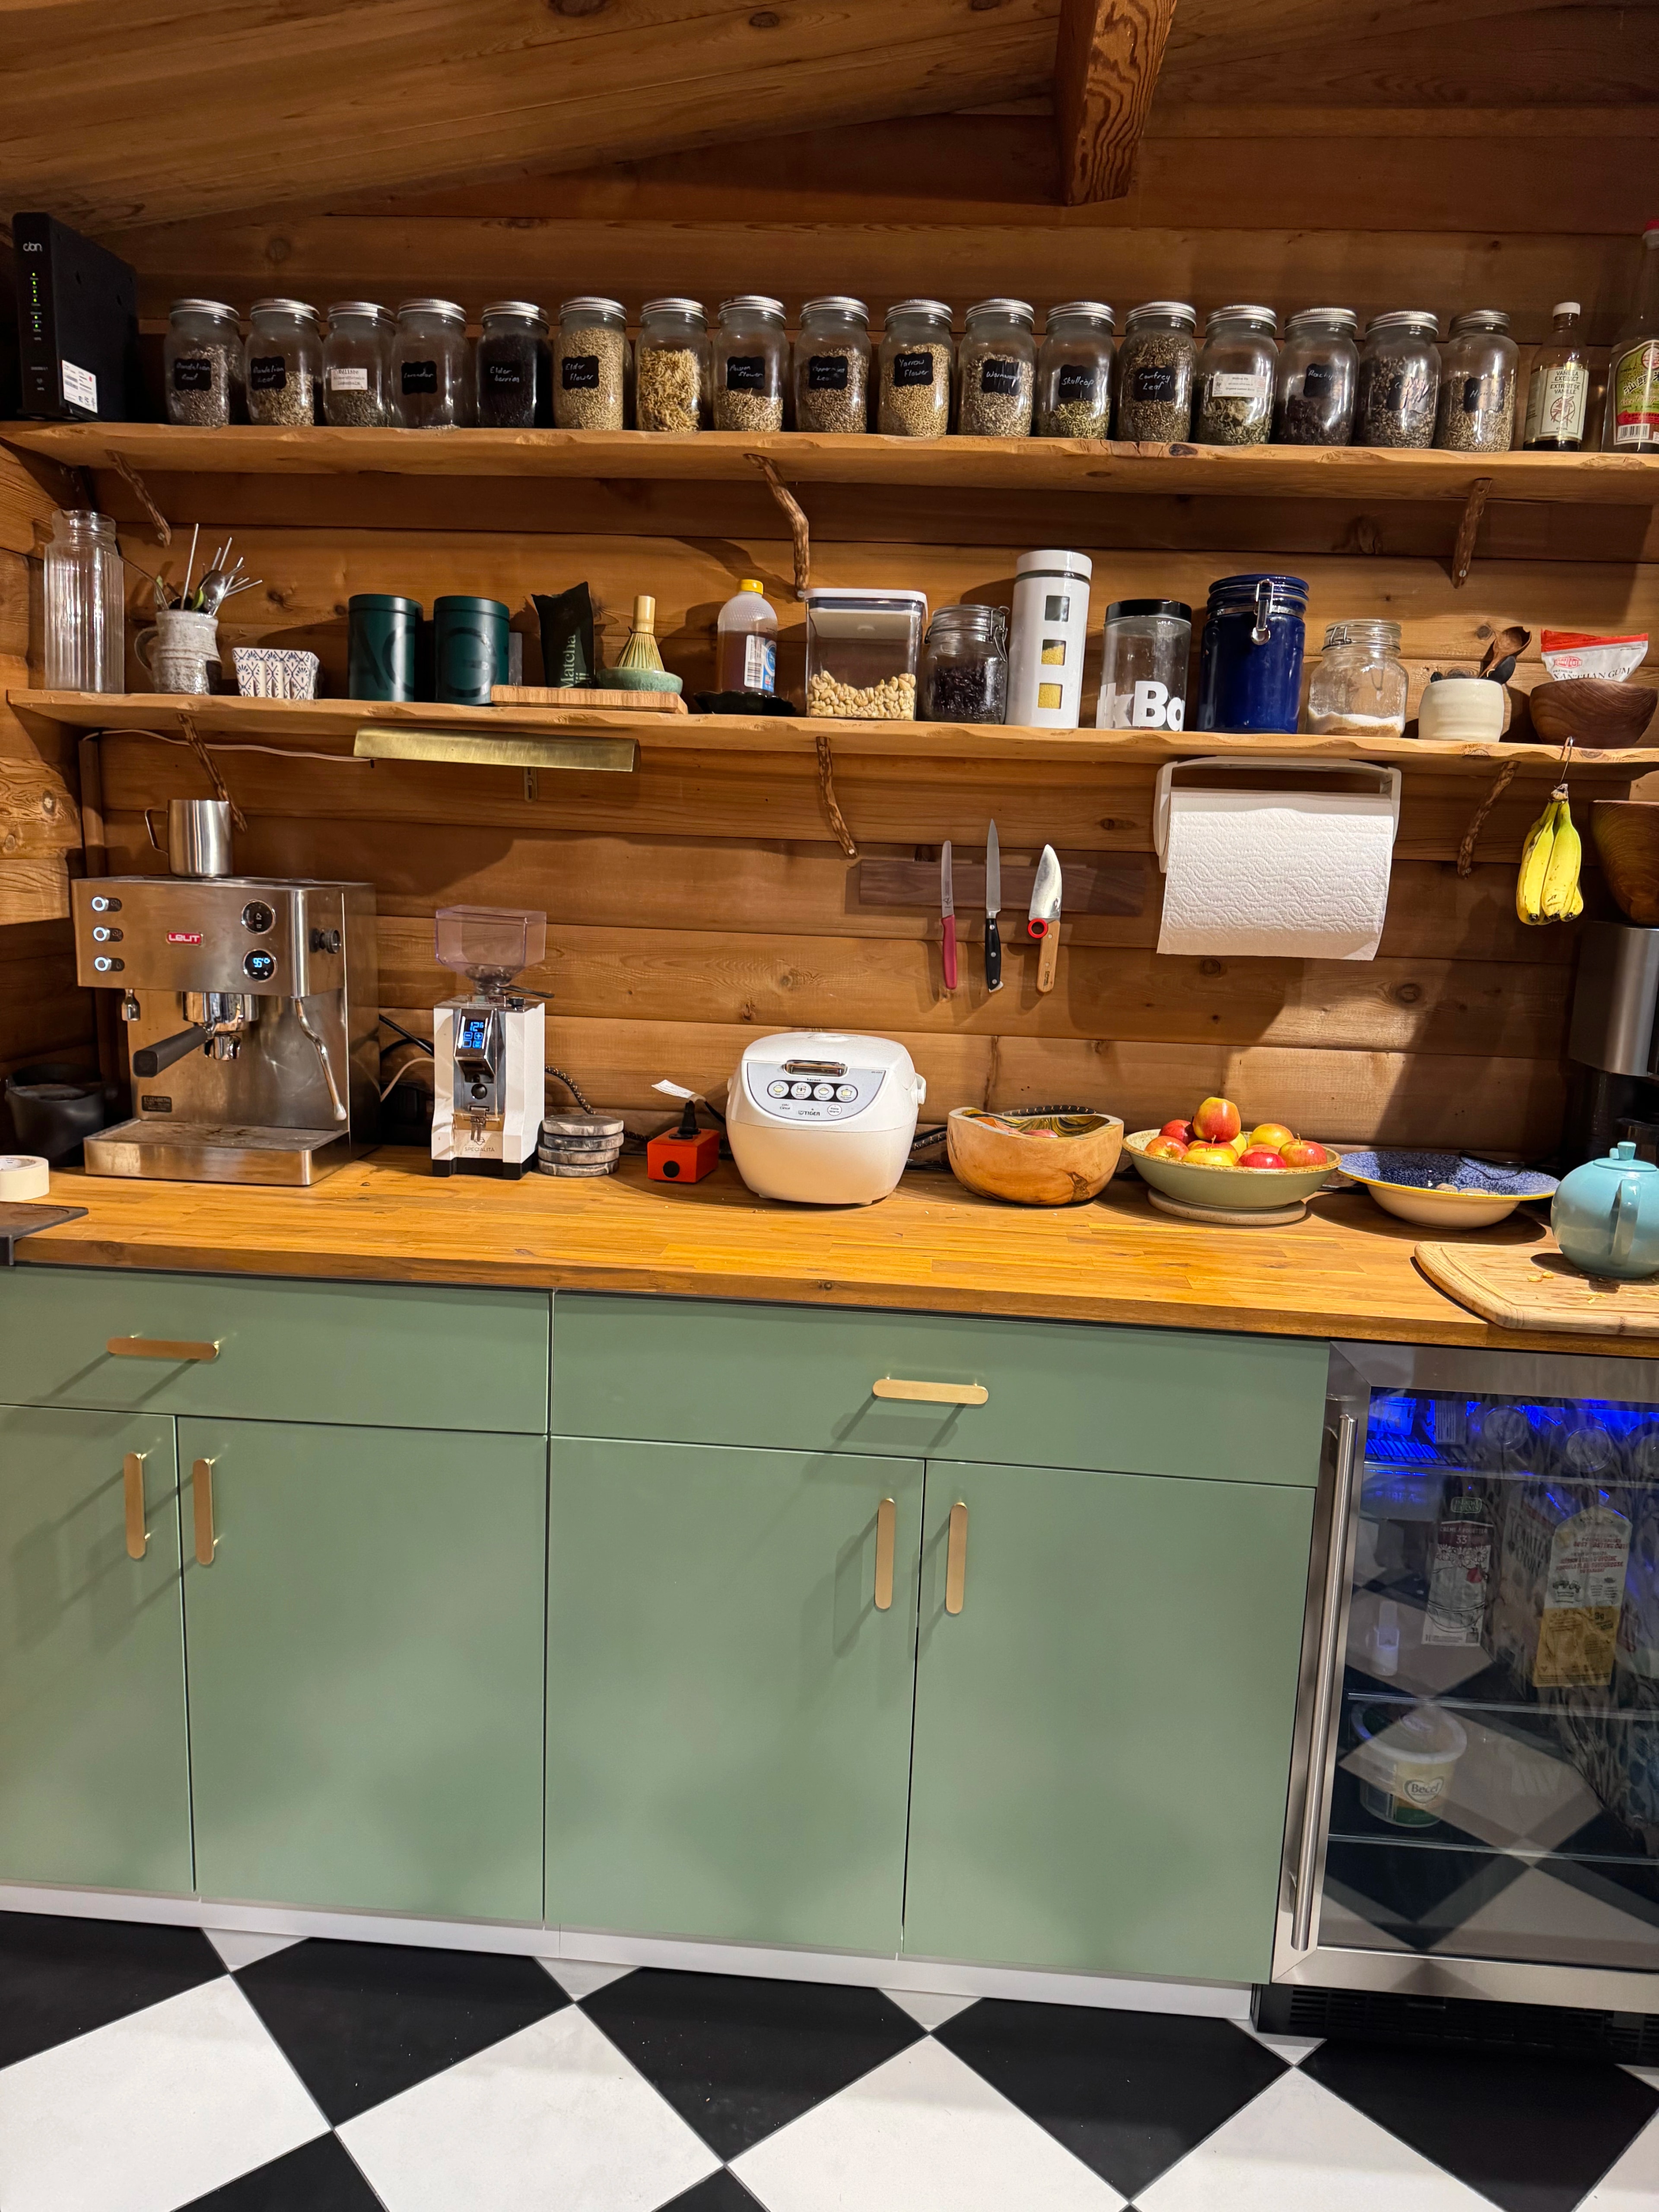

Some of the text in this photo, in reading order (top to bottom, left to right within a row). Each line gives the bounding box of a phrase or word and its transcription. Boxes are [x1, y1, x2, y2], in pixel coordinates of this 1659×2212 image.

[899, 359, 925, 367] Yarrow
[1062, 376, 1094, 388] Skullcap
[1138, 371, 1171, 384] Comfrey
[1142, 381, 1164, 391] Leaf
[560, 634, 576, 688] Matcha
[1608, 667, 1630, 678] GUM
[1411, 1783, 1440, 1793] Becel
